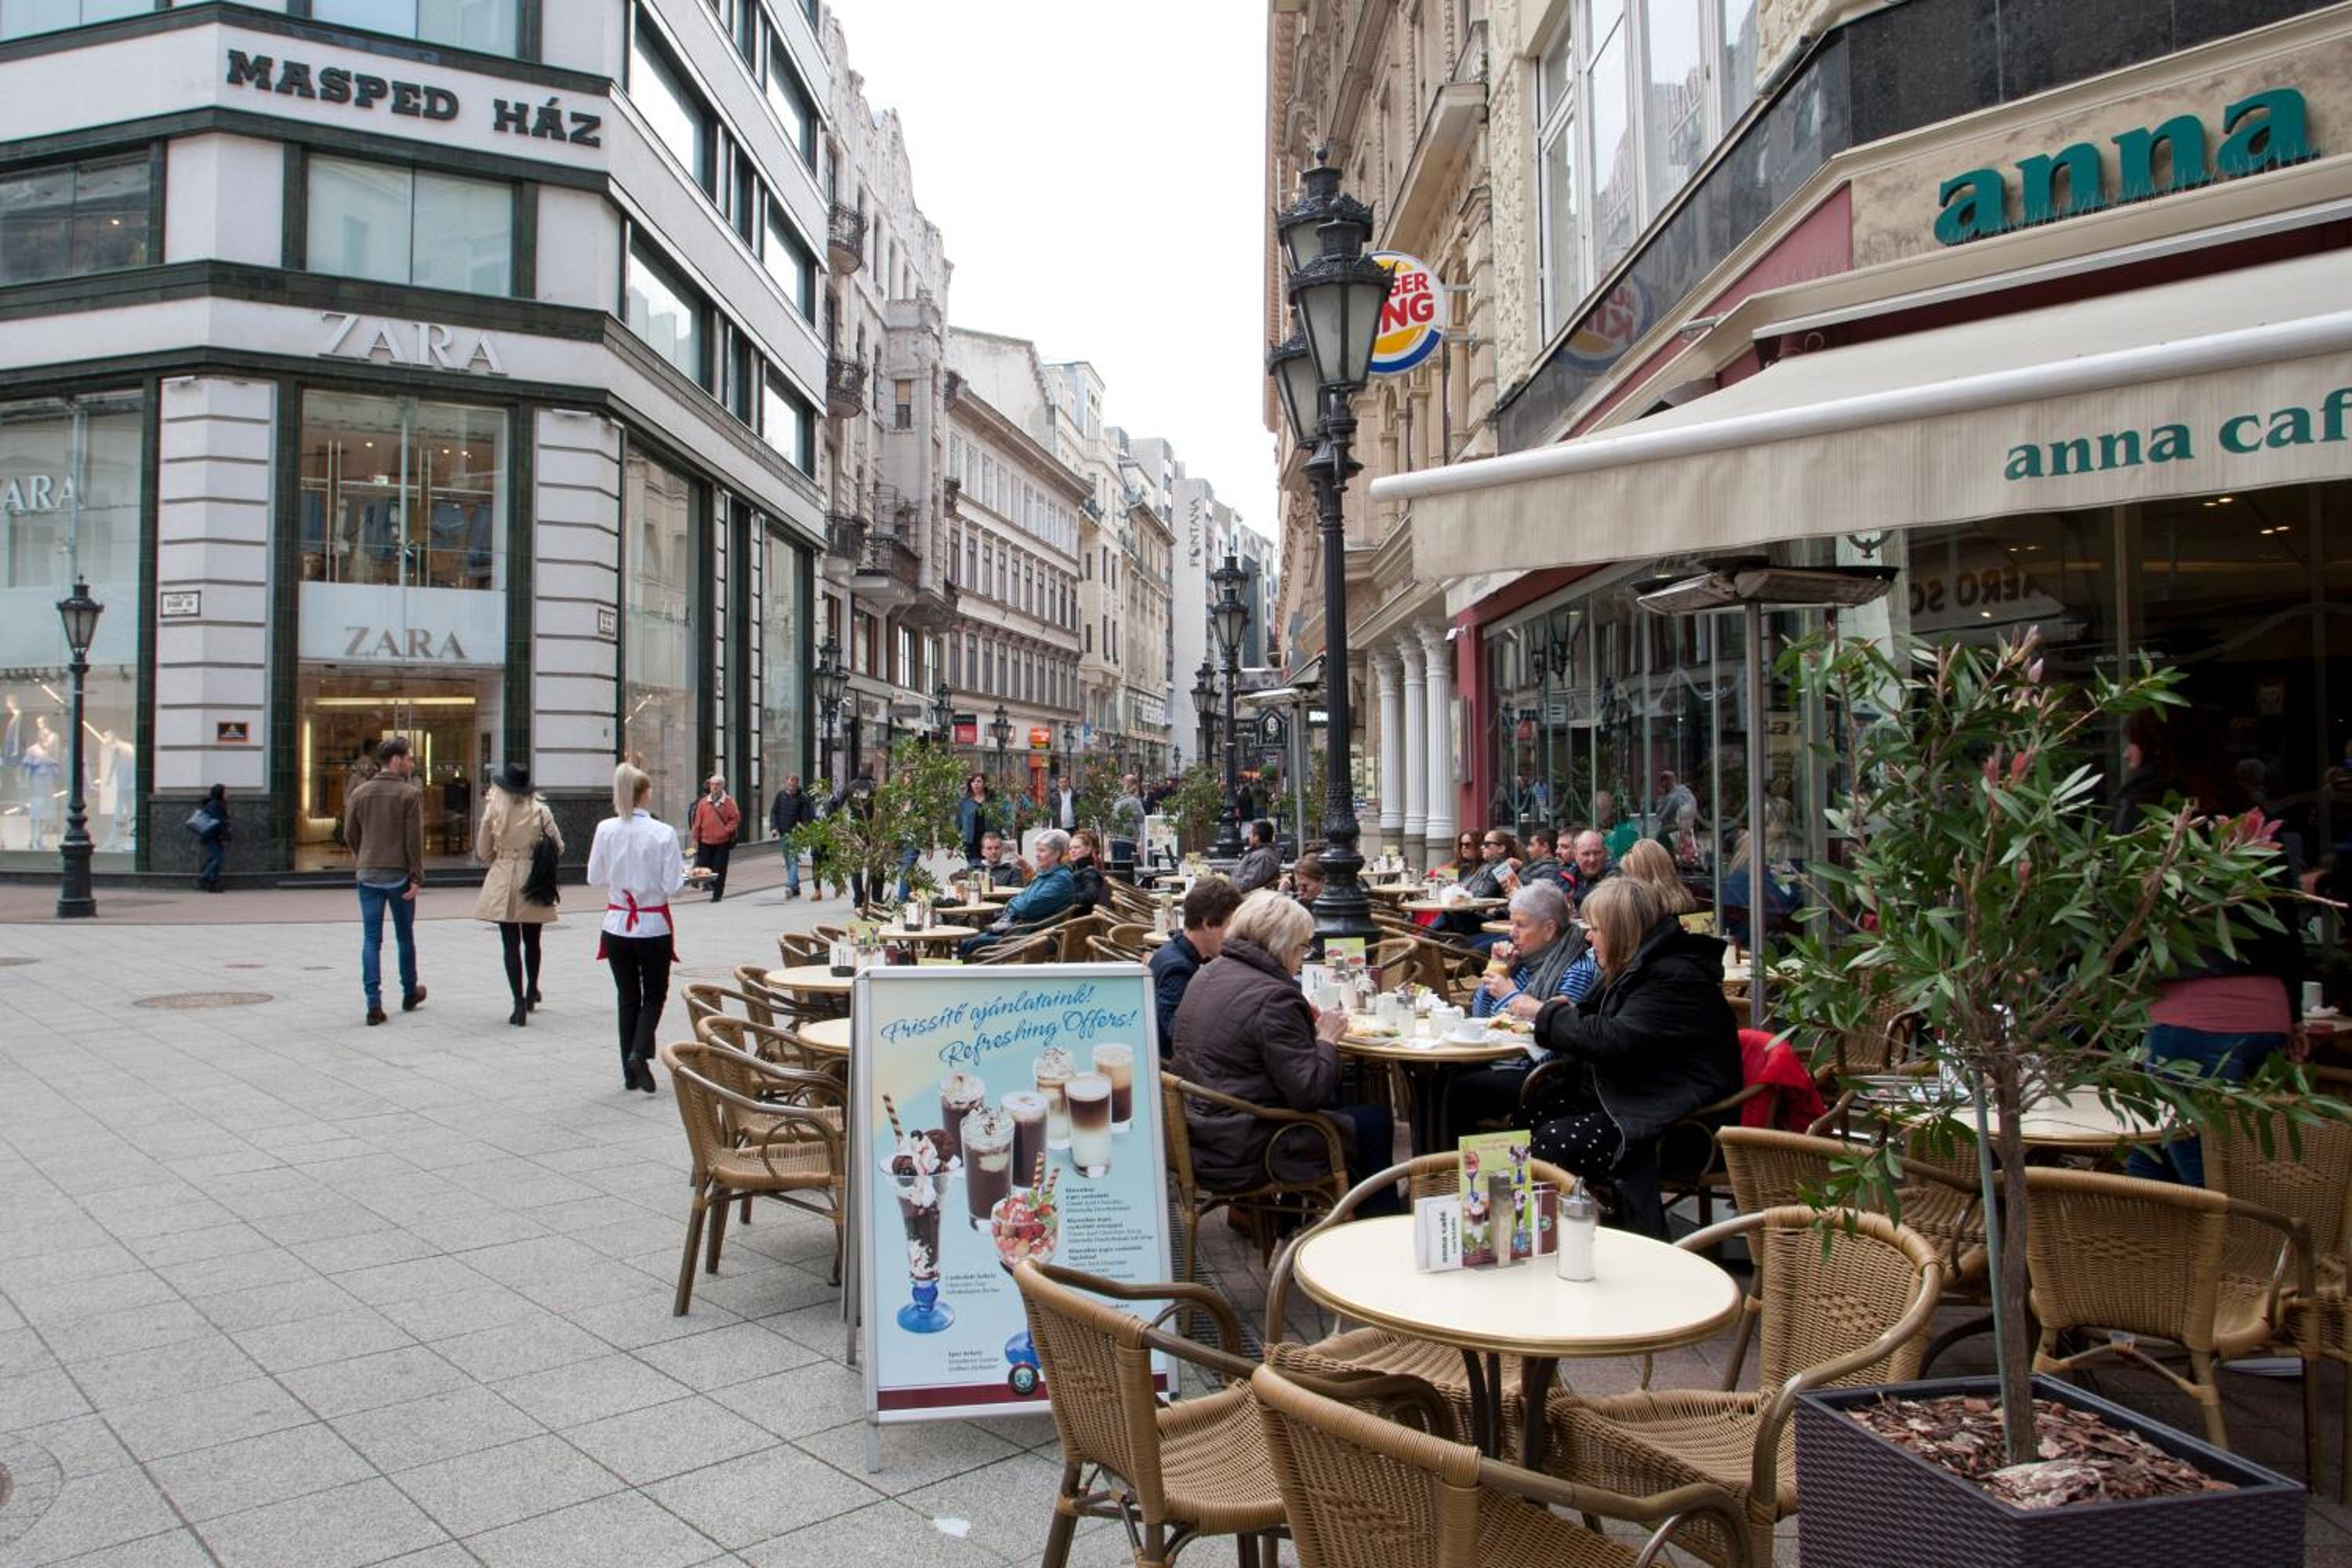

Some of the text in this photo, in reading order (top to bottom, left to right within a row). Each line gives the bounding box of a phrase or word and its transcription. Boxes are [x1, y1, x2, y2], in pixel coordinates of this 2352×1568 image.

[227, 49, 601, 148] MASPED HÁZ
[1933, 86, 2308, 246] anna
[1390, 271, 1429, 297] GER
[1382, 292, 1434, 334] NG
[318, 312, 507, 376] ZARA
[2004, 387, 2352, 481] anna caf
[4, 474, 88, 513] ARA
[345, 626, 466, 659] ZARA
[970, 982, 1095, 1030] ajánlataink!
[938, 1009, 1138, 1067] Refreshing Offers!
